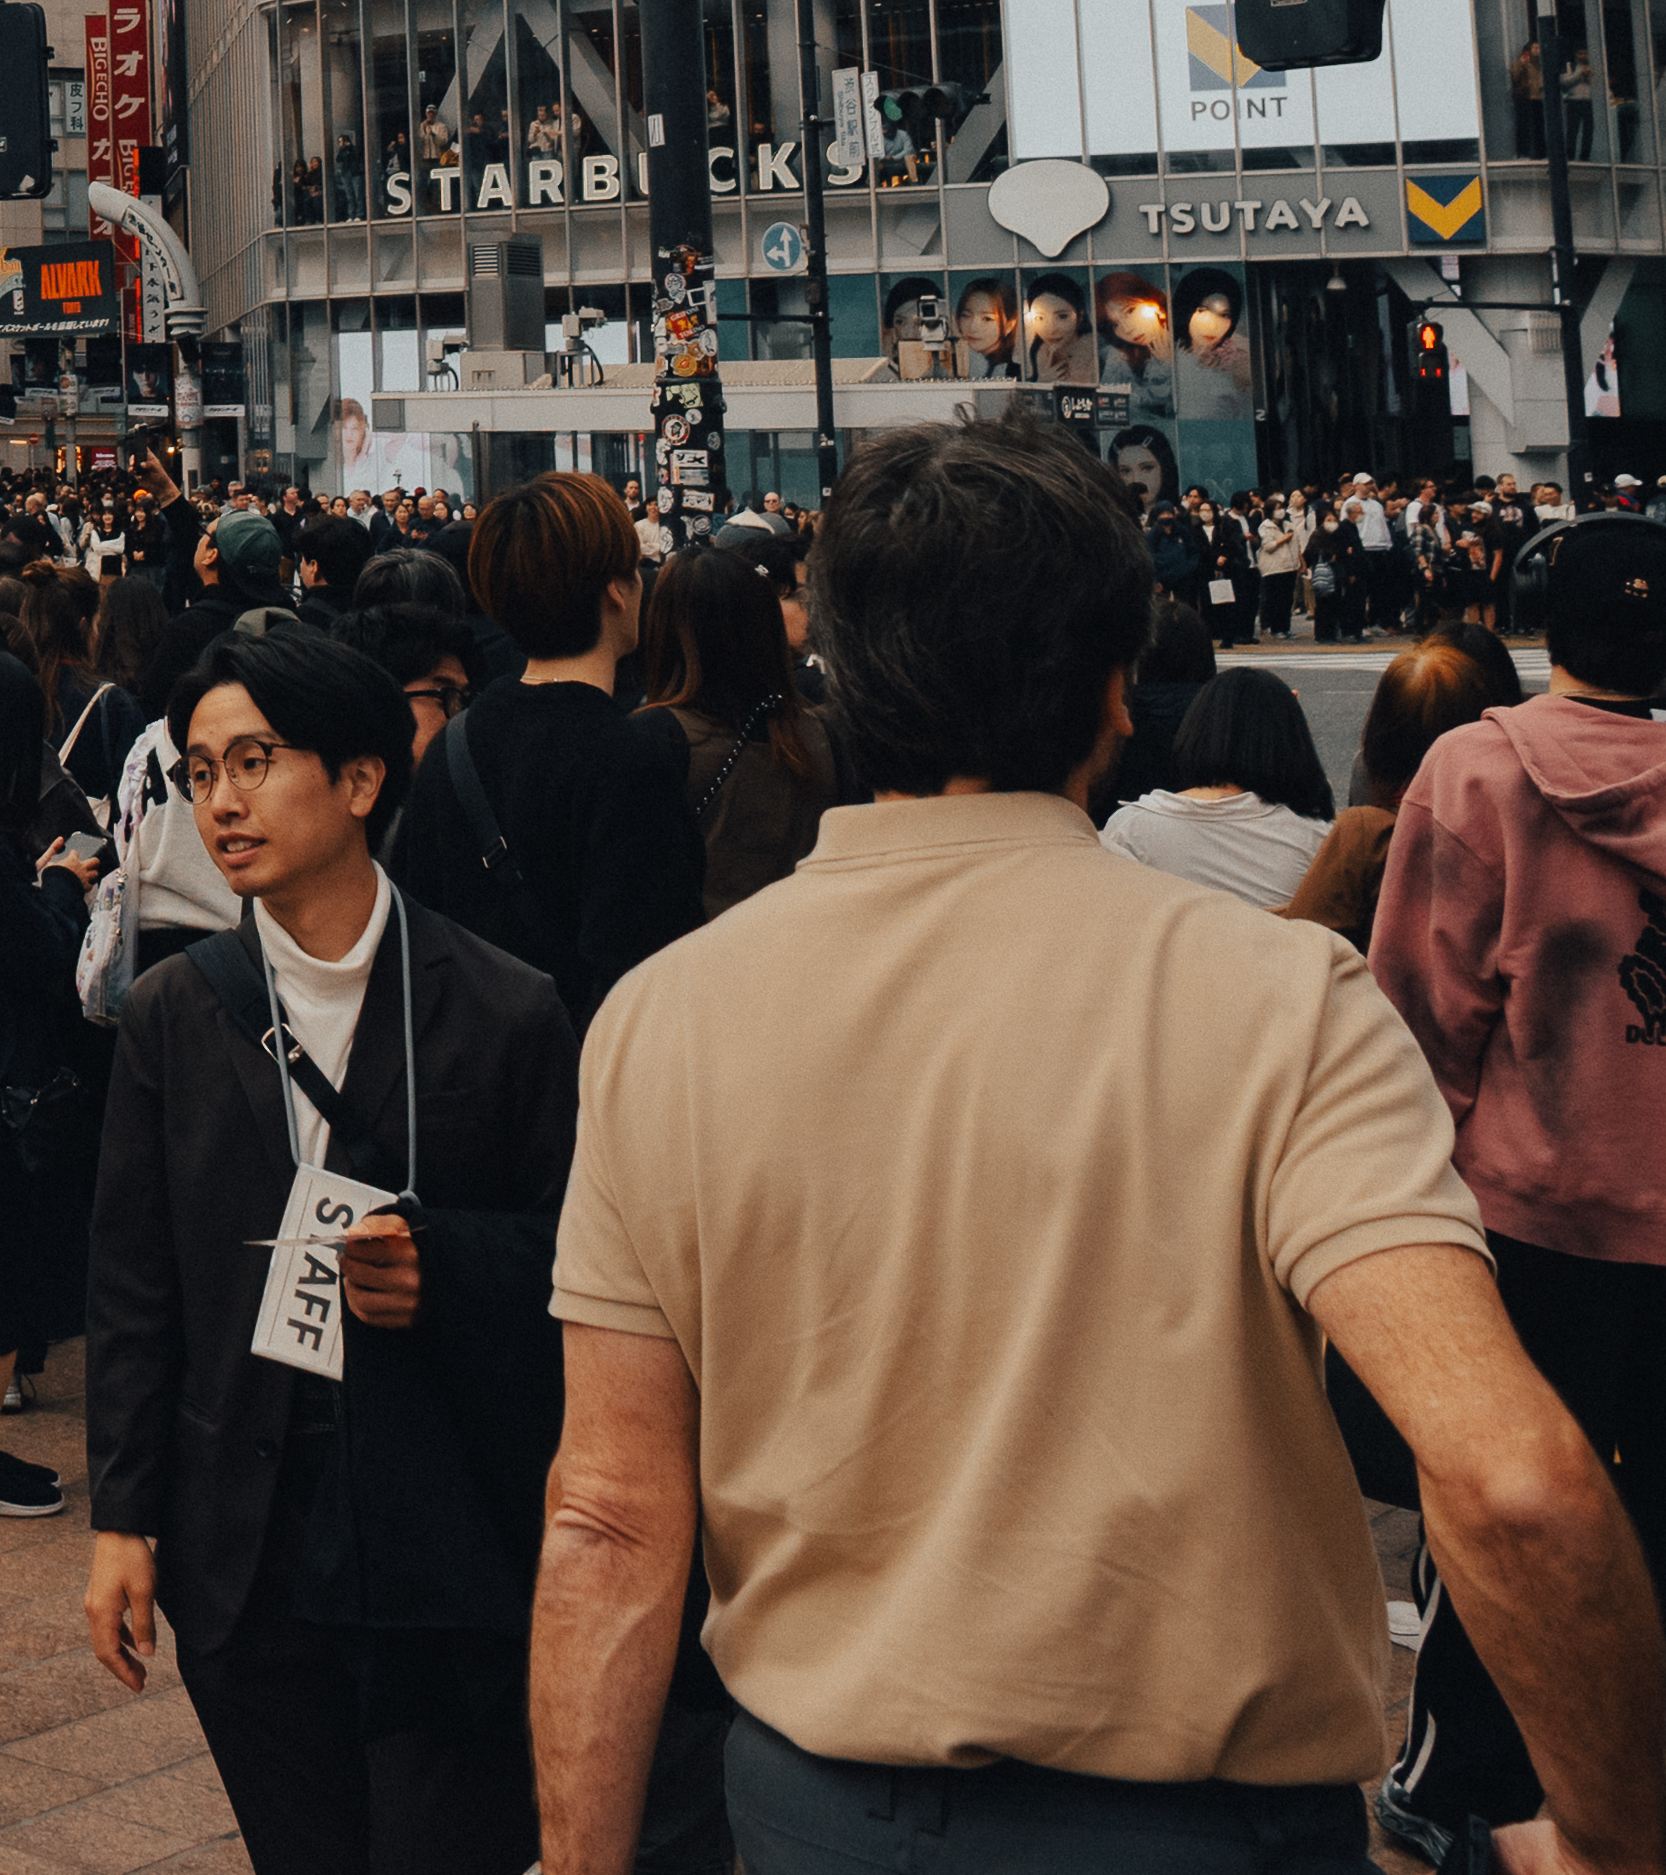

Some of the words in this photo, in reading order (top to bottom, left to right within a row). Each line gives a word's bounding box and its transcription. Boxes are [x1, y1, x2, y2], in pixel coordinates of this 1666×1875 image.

[90, 37, 108, 71] BIG
[70, 83, 84, 131] 皮フ科
[92, 73, 109, 121] ECHO
[1191, 96, 1288, 122] POINT
[386, 140, 865, 216] STARBCKS
[1139, 196, 1370, 235] TSUTAYA
